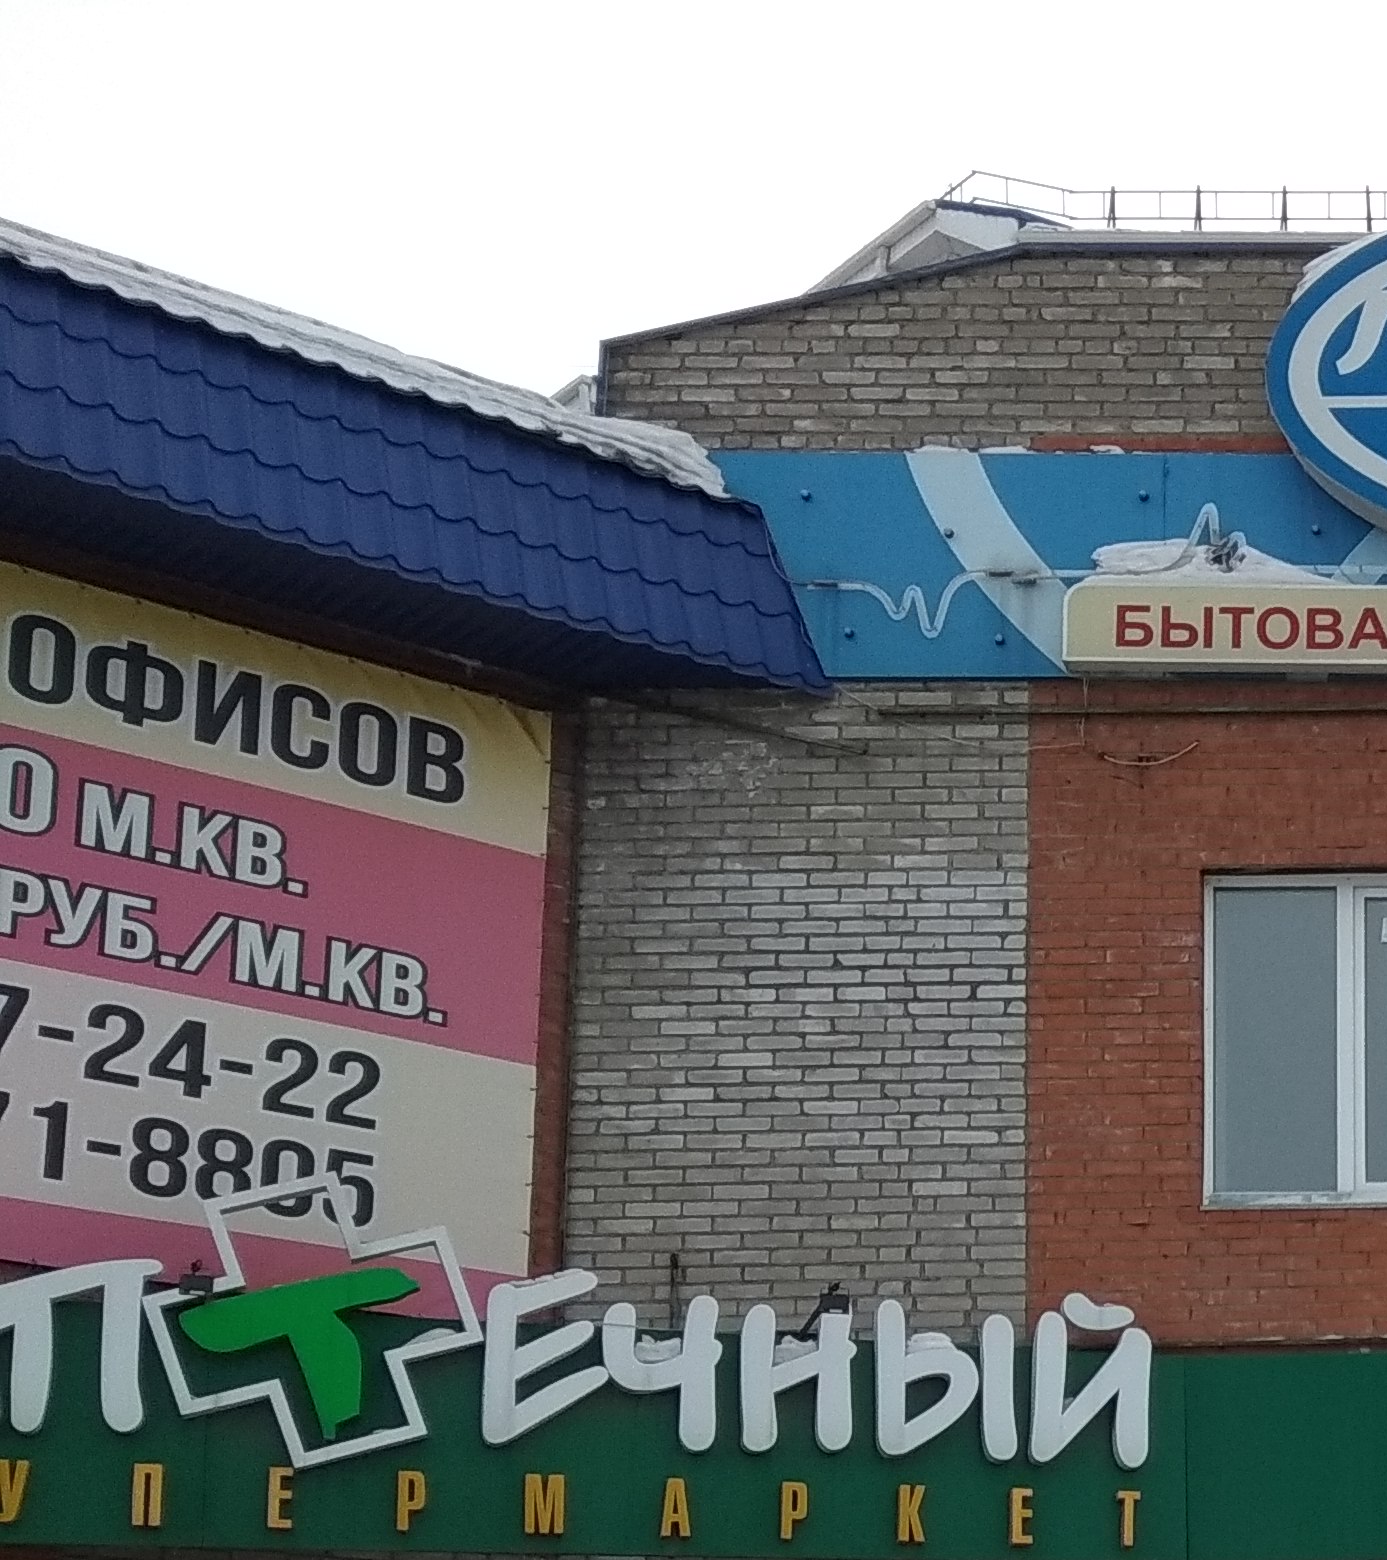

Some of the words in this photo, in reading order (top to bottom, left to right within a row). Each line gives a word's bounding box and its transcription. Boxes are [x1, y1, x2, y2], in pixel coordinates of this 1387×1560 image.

[8, 614, 466, 803] ОФИСОВ
[75, 778, 309, 898] М.КВ.
[0, 867, 448, 1027] РУБ./М.КВ.
[0, 1459, 1141, 1547] УПЕРМАРКЕТ
